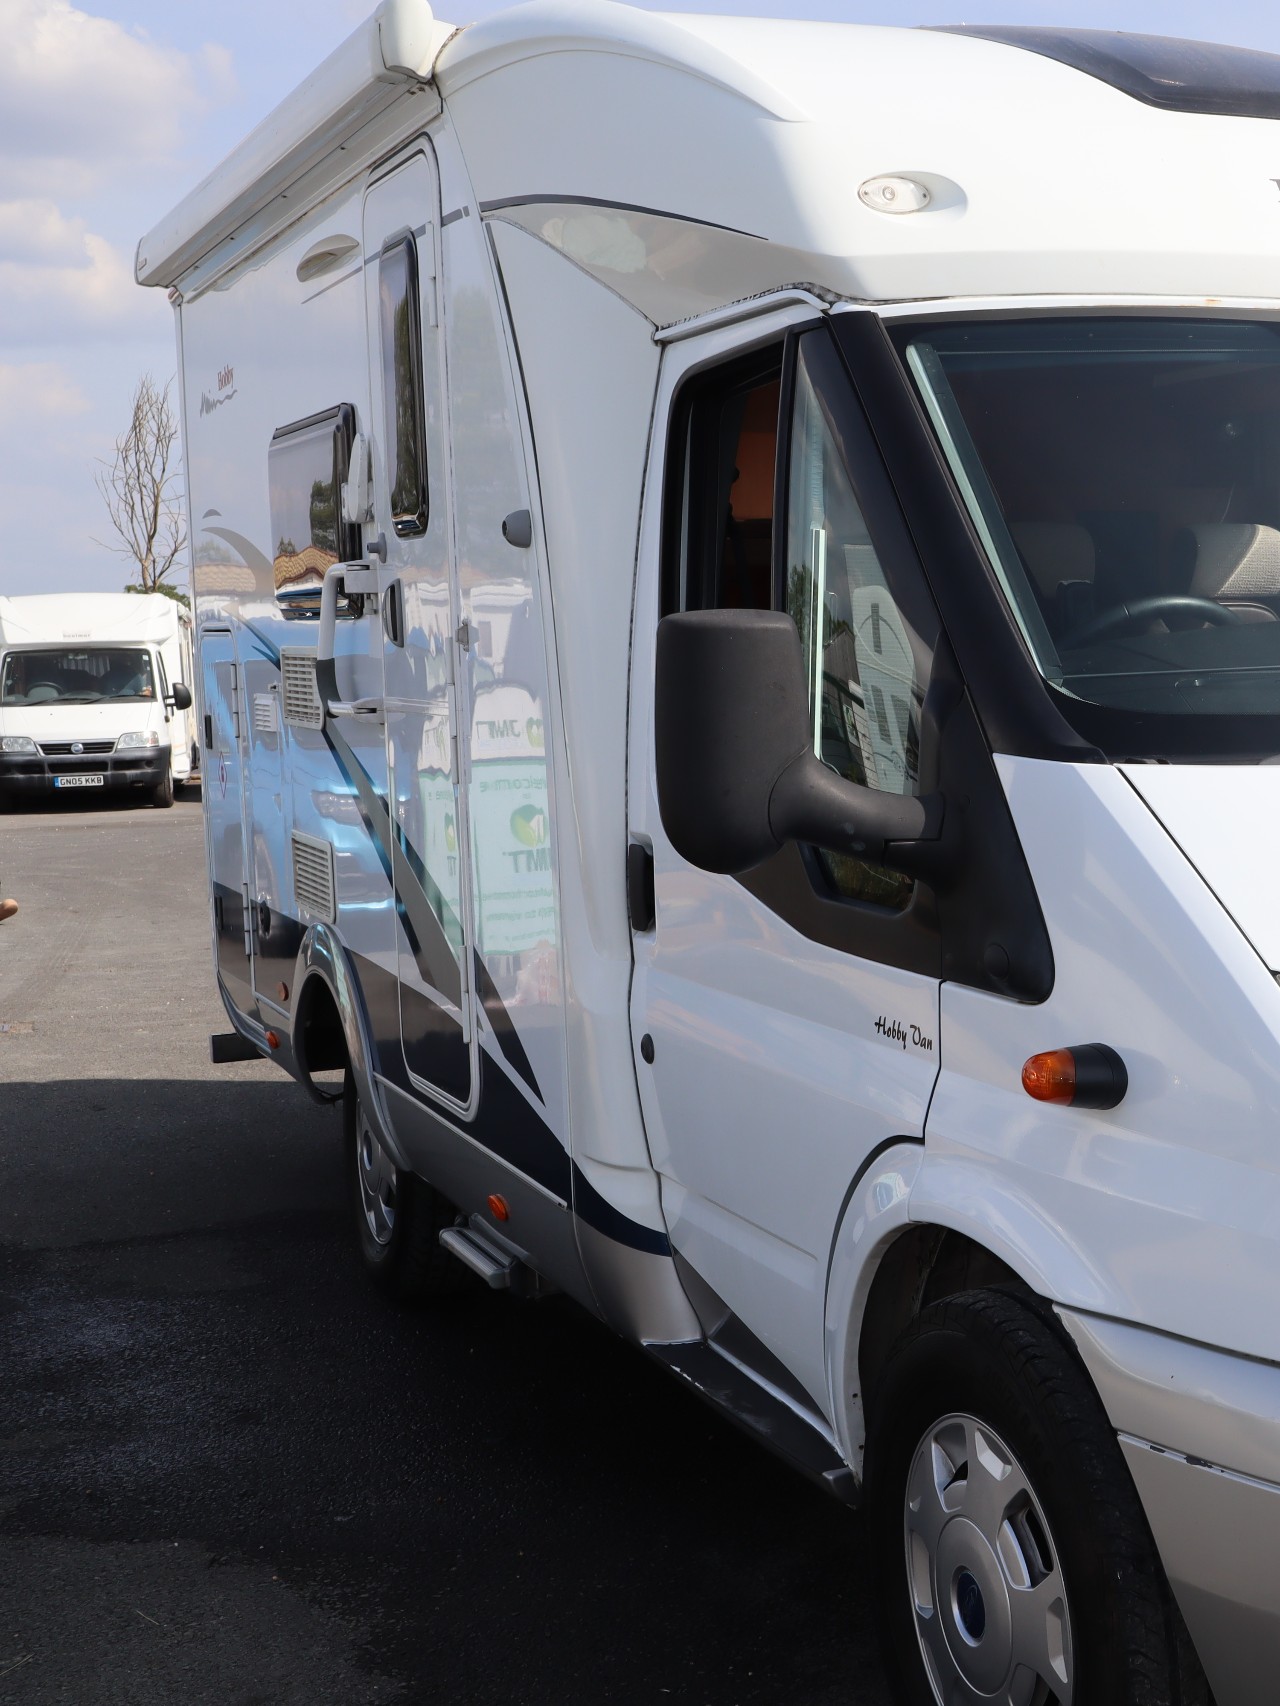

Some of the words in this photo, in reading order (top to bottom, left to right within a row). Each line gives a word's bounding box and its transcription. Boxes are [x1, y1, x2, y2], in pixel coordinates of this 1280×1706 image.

[60, 777, 83, 786] GN05
[84, 776, 102, 785] KKB
[874, 1015, 907, 1050] Hobby
[909, 1024, 933, 1051] Van
